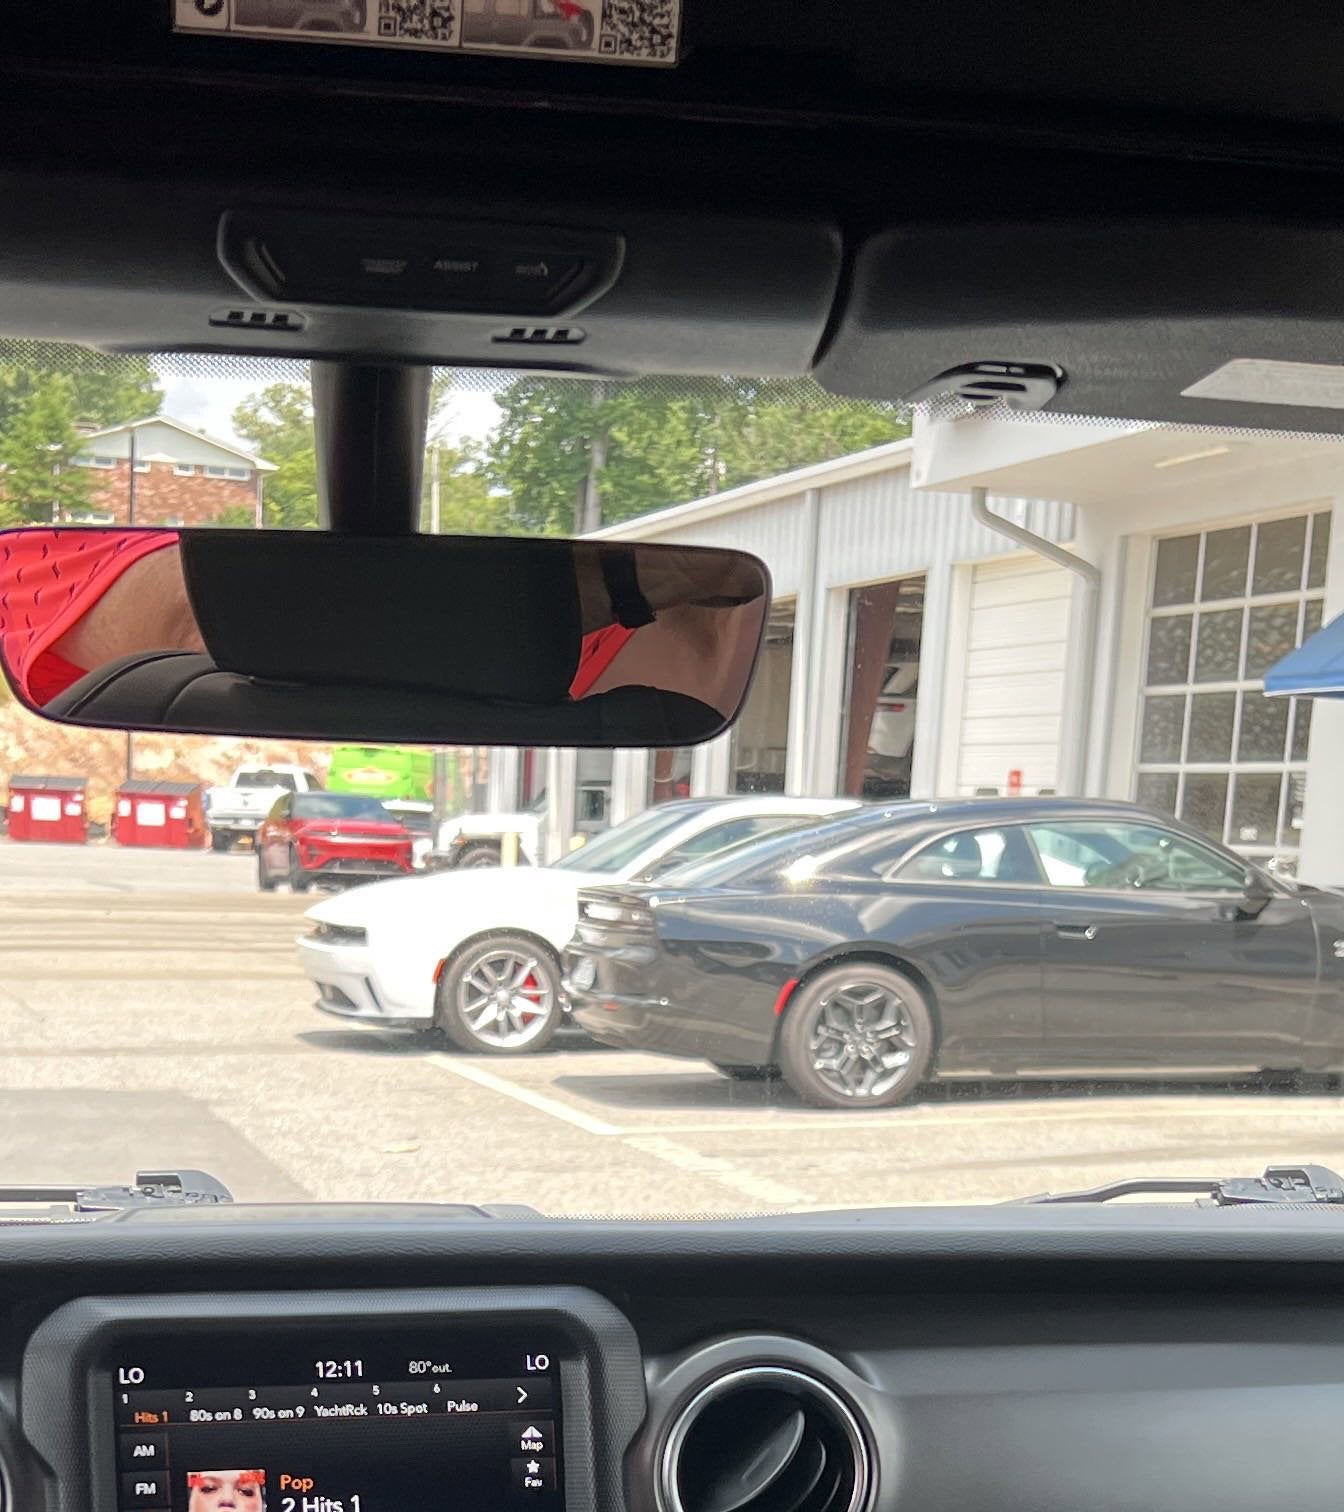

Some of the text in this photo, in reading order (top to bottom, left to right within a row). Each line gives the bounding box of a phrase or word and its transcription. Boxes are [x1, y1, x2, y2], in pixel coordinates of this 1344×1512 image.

[525, 1353, 550, 1371] LO
[118, 1366, 145, 1385] LO
[315, 1359, 363, 1379] 12:11
[248, 1389, 257, 1401] 3
[310, 1387, 319, 1398] 4
[372, 1384, 380, 1396] 5
[433, 1383, 441, 1395] 6
[122, 1393, 129, 1404] 1
[184, 1391, 194, 1403] 2
[313, 1403, 369, 1418] YachtRck
[376, 1402, 429, 1417] 10s Spot
[447, 1399, 479, 1413] Pulse
[133, 1411, 160, 1424] Hits
[189, 1409, 214, 1422] 80s
[214, 1411, 232, 1421] on
[252, 1406, 305, 1420] 90s on 9
[133, 1444, 155, 1458] AM
[520, 1439, 544, 1452] Map
[279, 1474, 314, 1493] Pop
[524, 1476, 543, 1488] Fav
[135, 1482, 157, 1496] FM
